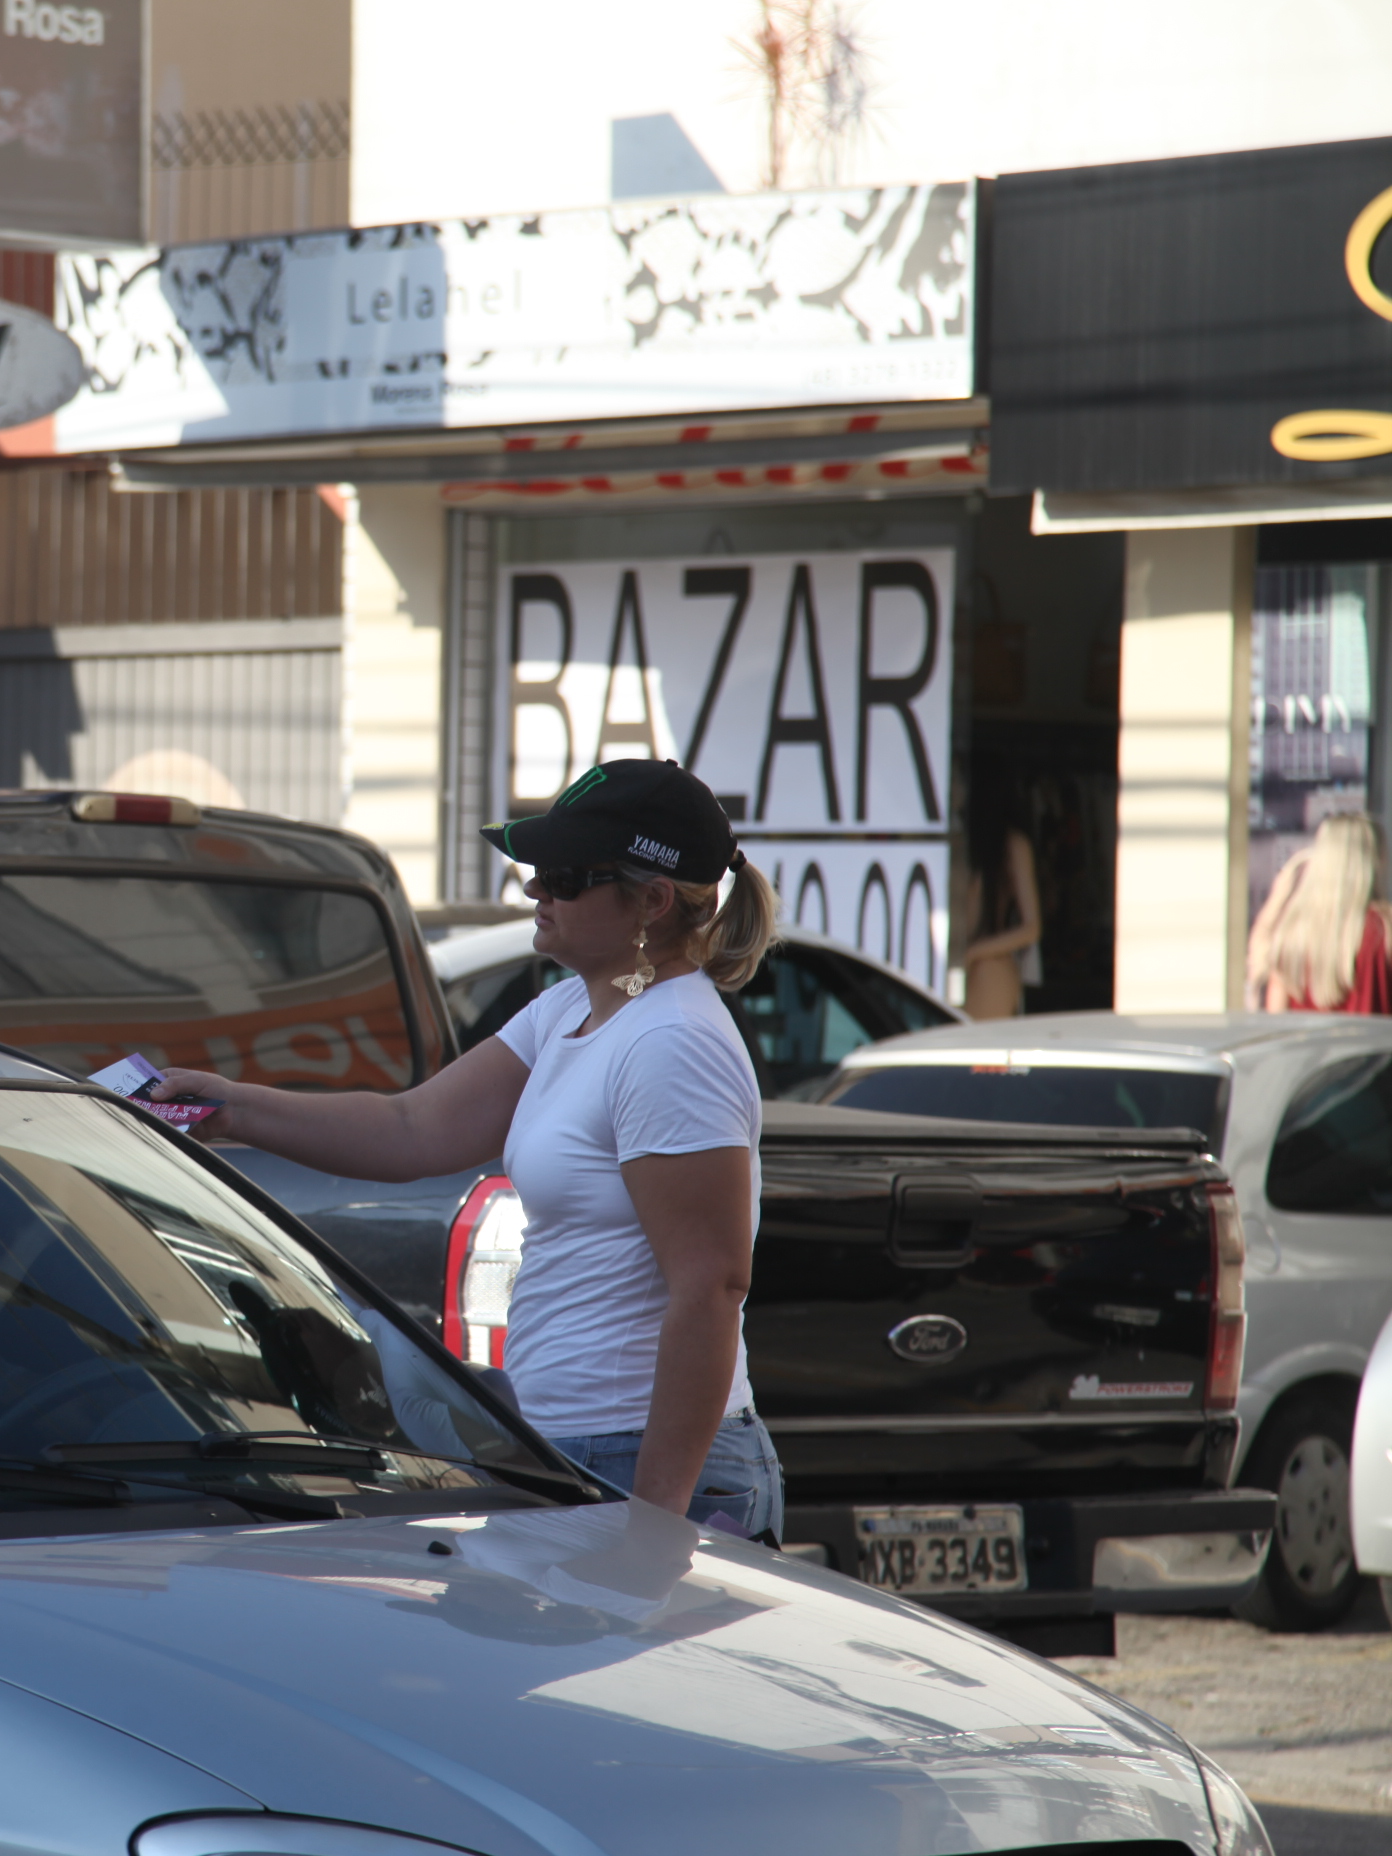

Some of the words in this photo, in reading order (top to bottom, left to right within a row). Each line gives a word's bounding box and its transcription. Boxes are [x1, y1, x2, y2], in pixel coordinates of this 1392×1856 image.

[3, 0, 106, 46] Rosa
[346, 267, 524, 327] Lelahel
[511, 558, 942, 824] BAZAR
[627, 846, 657, 862] RACING
[656, 858, 678, 870] TEAM
[633, 834, 681, 864] YAMAHA
[908, 1323, 952, 1351] Ford
